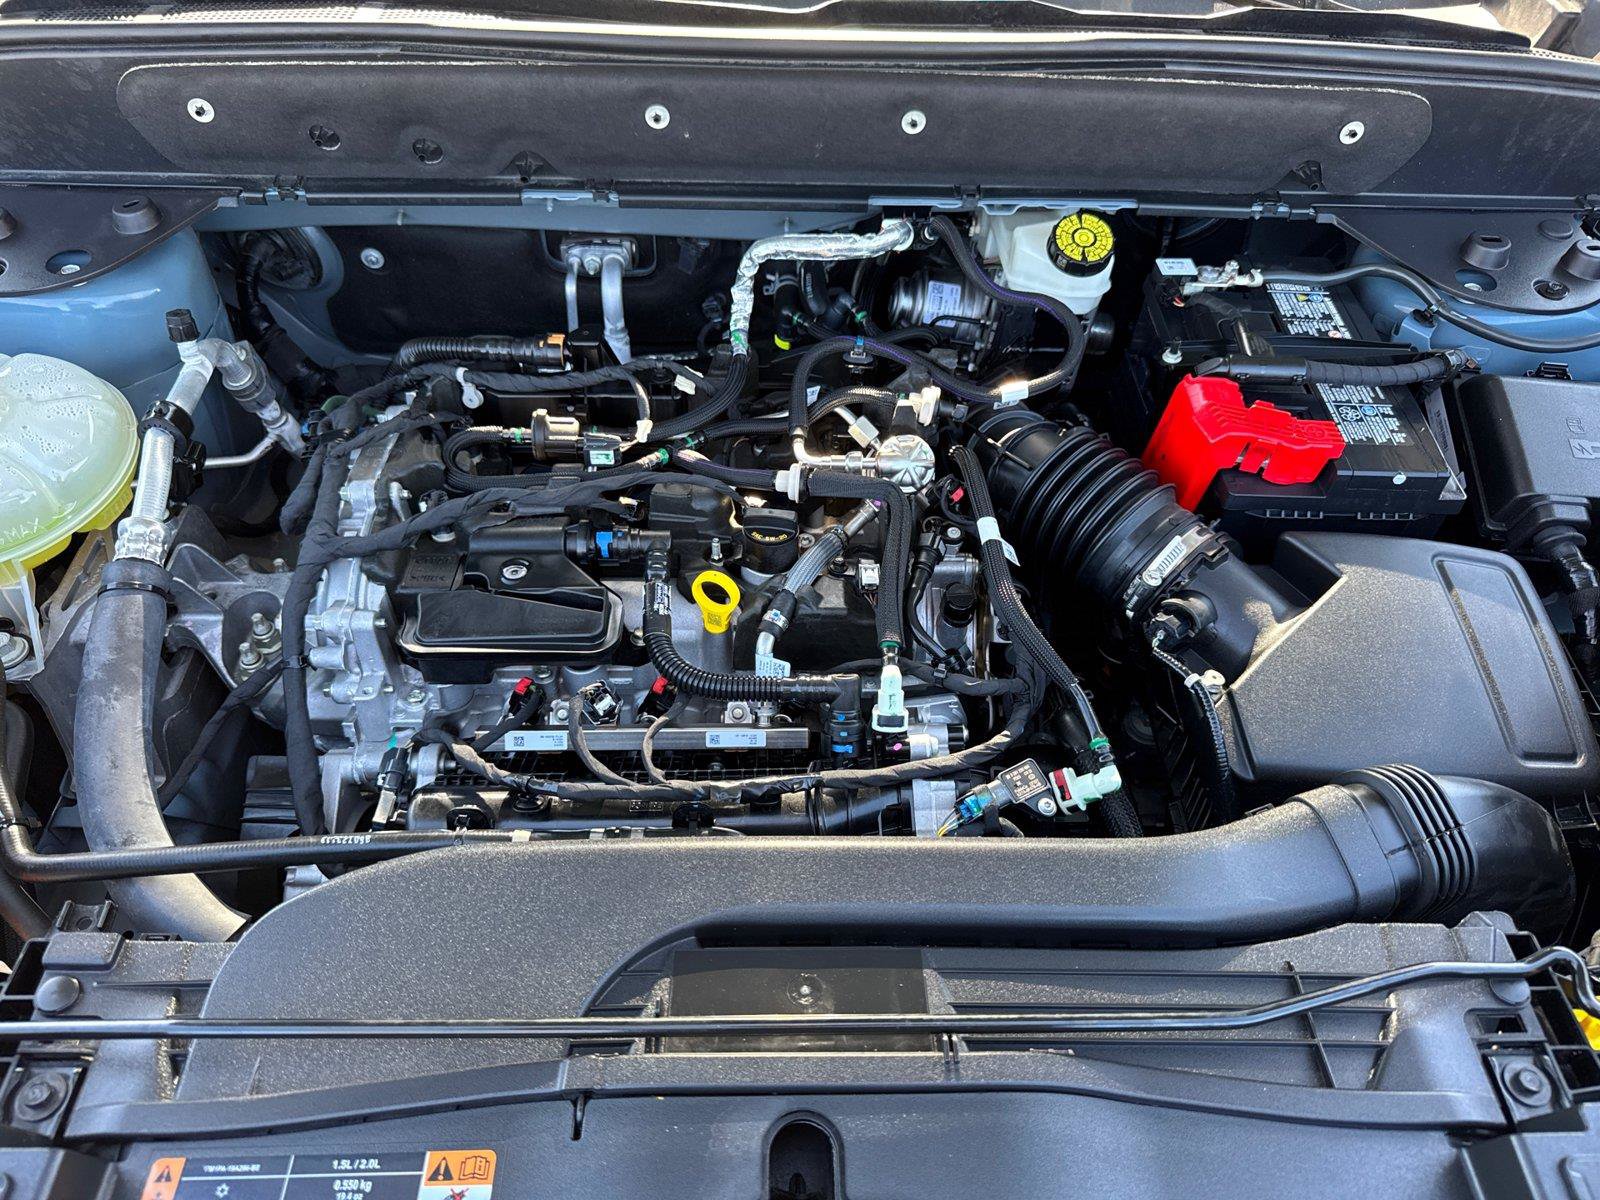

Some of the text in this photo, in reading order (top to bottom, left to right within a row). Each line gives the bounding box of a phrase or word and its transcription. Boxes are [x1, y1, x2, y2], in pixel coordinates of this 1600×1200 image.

[332, 1159, 353, 1170] 1.5L
[359, 1158, 381, 1170] 2.0L
[360, 1178, 373, 1193] kg
